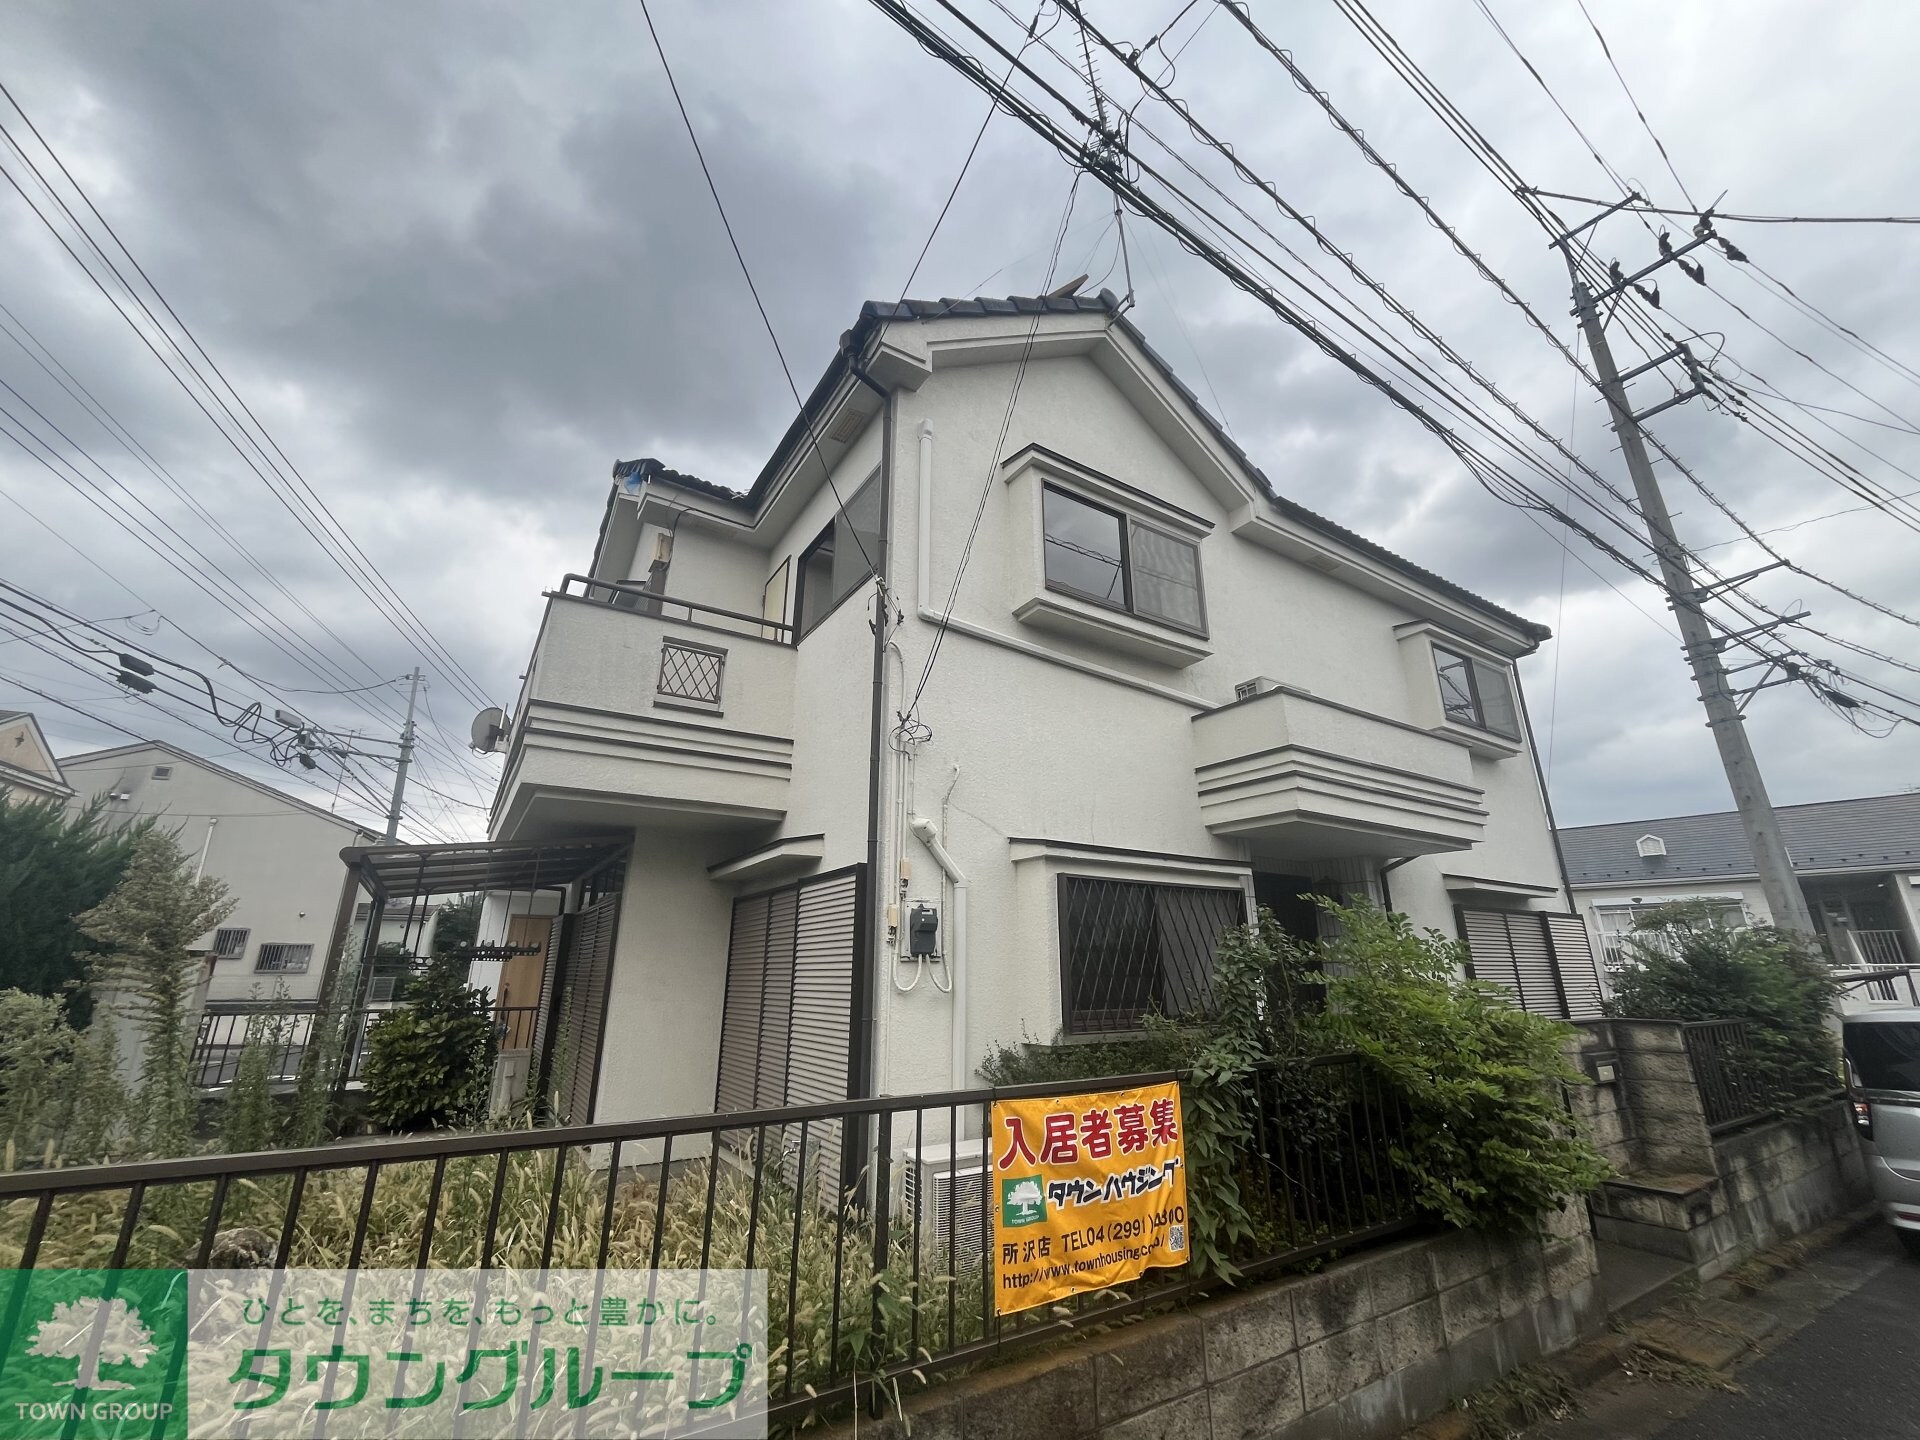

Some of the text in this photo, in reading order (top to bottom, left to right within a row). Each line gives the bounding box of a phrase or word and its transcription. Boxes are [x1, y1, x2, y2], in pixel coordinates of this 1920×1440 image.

[998, 1098, 1178, 1170] 入居者募集
[1048, 1157, 1180, 1208] タウンハウジング
[1002, 1236, 1051, 1265] 所沢店
